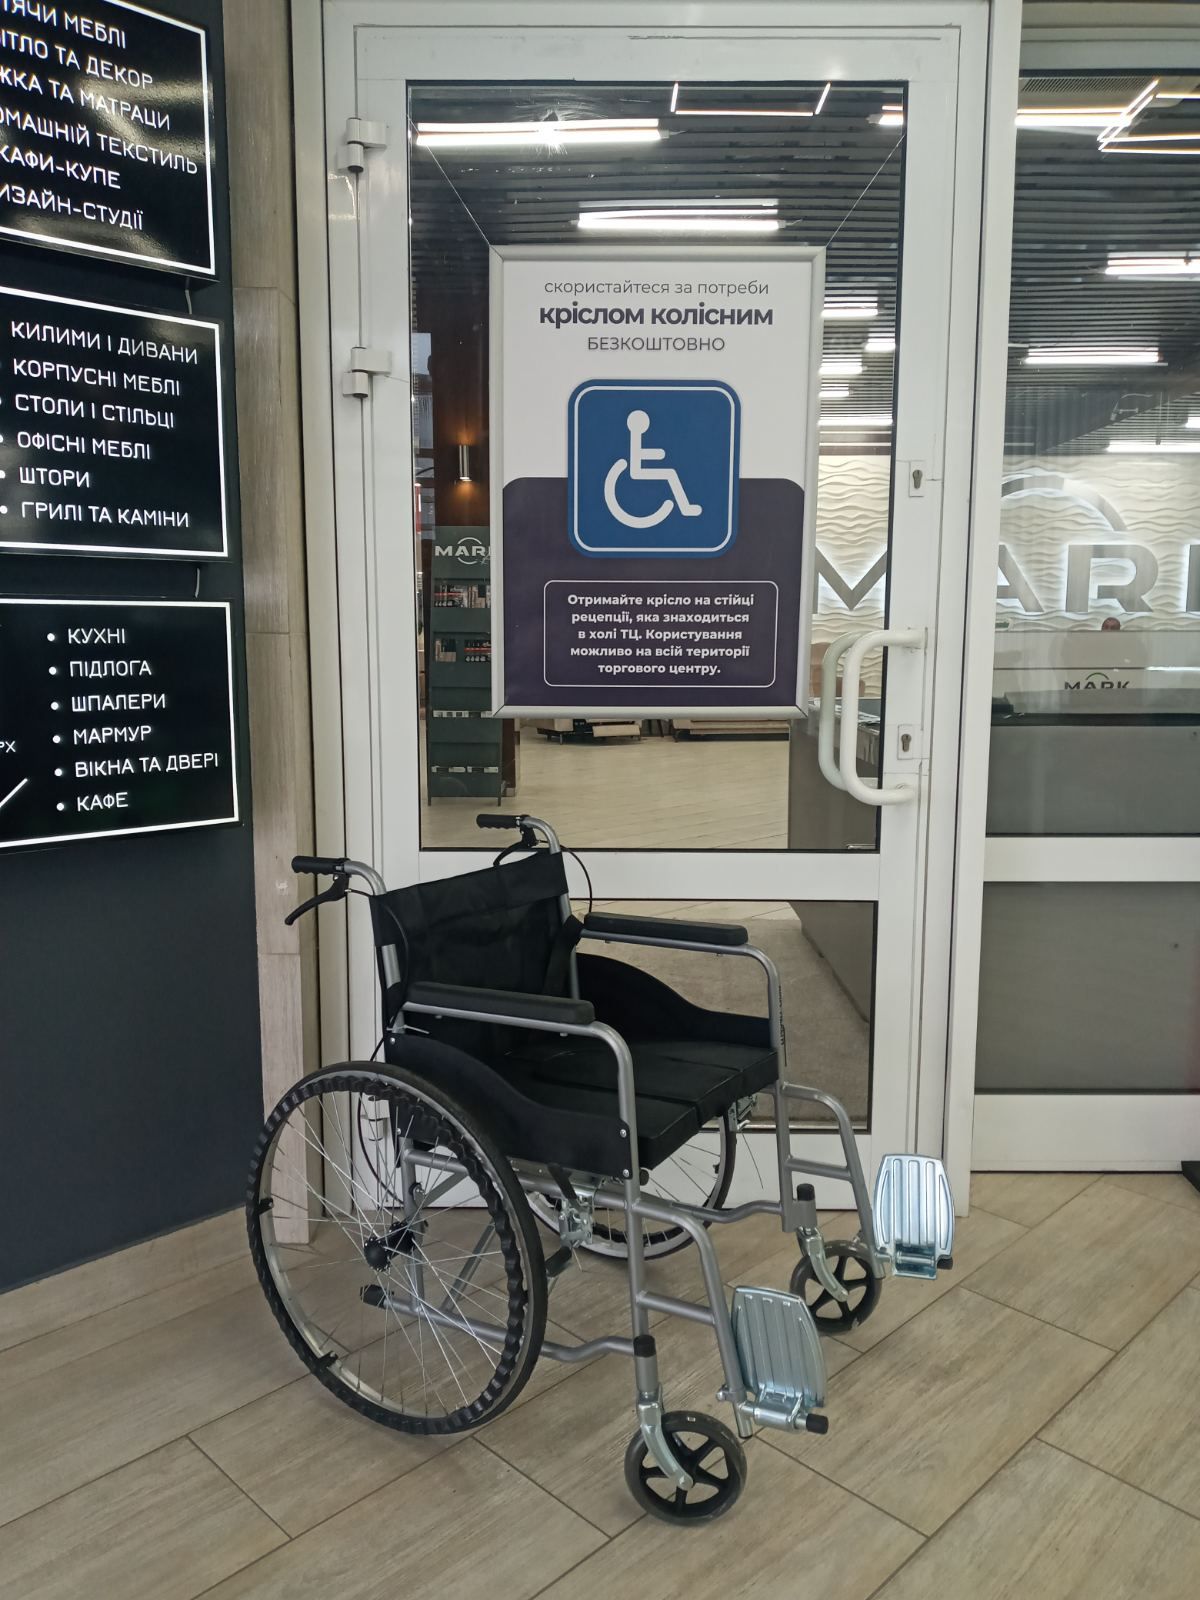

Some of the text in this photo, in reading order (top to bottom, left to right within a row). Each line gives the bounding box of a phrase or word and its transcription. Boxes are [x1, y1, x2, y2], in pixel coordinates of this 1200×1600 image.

[64, 11, 126, 49] МЕБЛІ
[0, 29, 154, 91] ІТЛО ТА ДЕКОР
[48, 79, 75, 104] ТА
[80, 88, 170, 131] МАТРАЦИ
[96, 132, 198, 174] ТЕКСТИЛЬ
[544, 279, 769, 297] скористайтеся за потреби
[539, 300, 773, 330] кріслом колісним
[11, 320, 198, 365] КИЛИМИ І ДИВАНИ
[587, 336, 726, 352] БЕЗКОШТОВНО
[13, 358, 180, 396] КОРПУСНІ МЕБЛІ
[15, 393, 174, 429] СТОЛИ І СТІЛЬЦІ
[17, 431, 150, 460] ОФІСНІ МЕБЛІ
[19, 466, 90, 488] ШТОРИ
[21, 501, 189, 528] ГРИЛІ ТА КАМІНИ
[434, 545, 490, 557] MAR
[567, 593, 755, 608] Отримайте крісло на стійці
[571, 610, 750, 625] рецепції, яка знаходиться
[68, 628, 125, 644] КУХНІ
[578, 627, 743, 642] в холі ТЦ. Користування
[570, 645, 751, 659] можливо на всій території
[69, 660, 152, 679] ПІДЛОГА
[597, 664, 721, 676] торгового центру.
[71, 693, 166, 712] ШПАЛЕРИ
[73, 725, 152, 745] МАРМУР
[75, 752, 218, 778] ВІКНА ТА ДВЕРІ
[77, 791, 129, 812] КАФЕ
